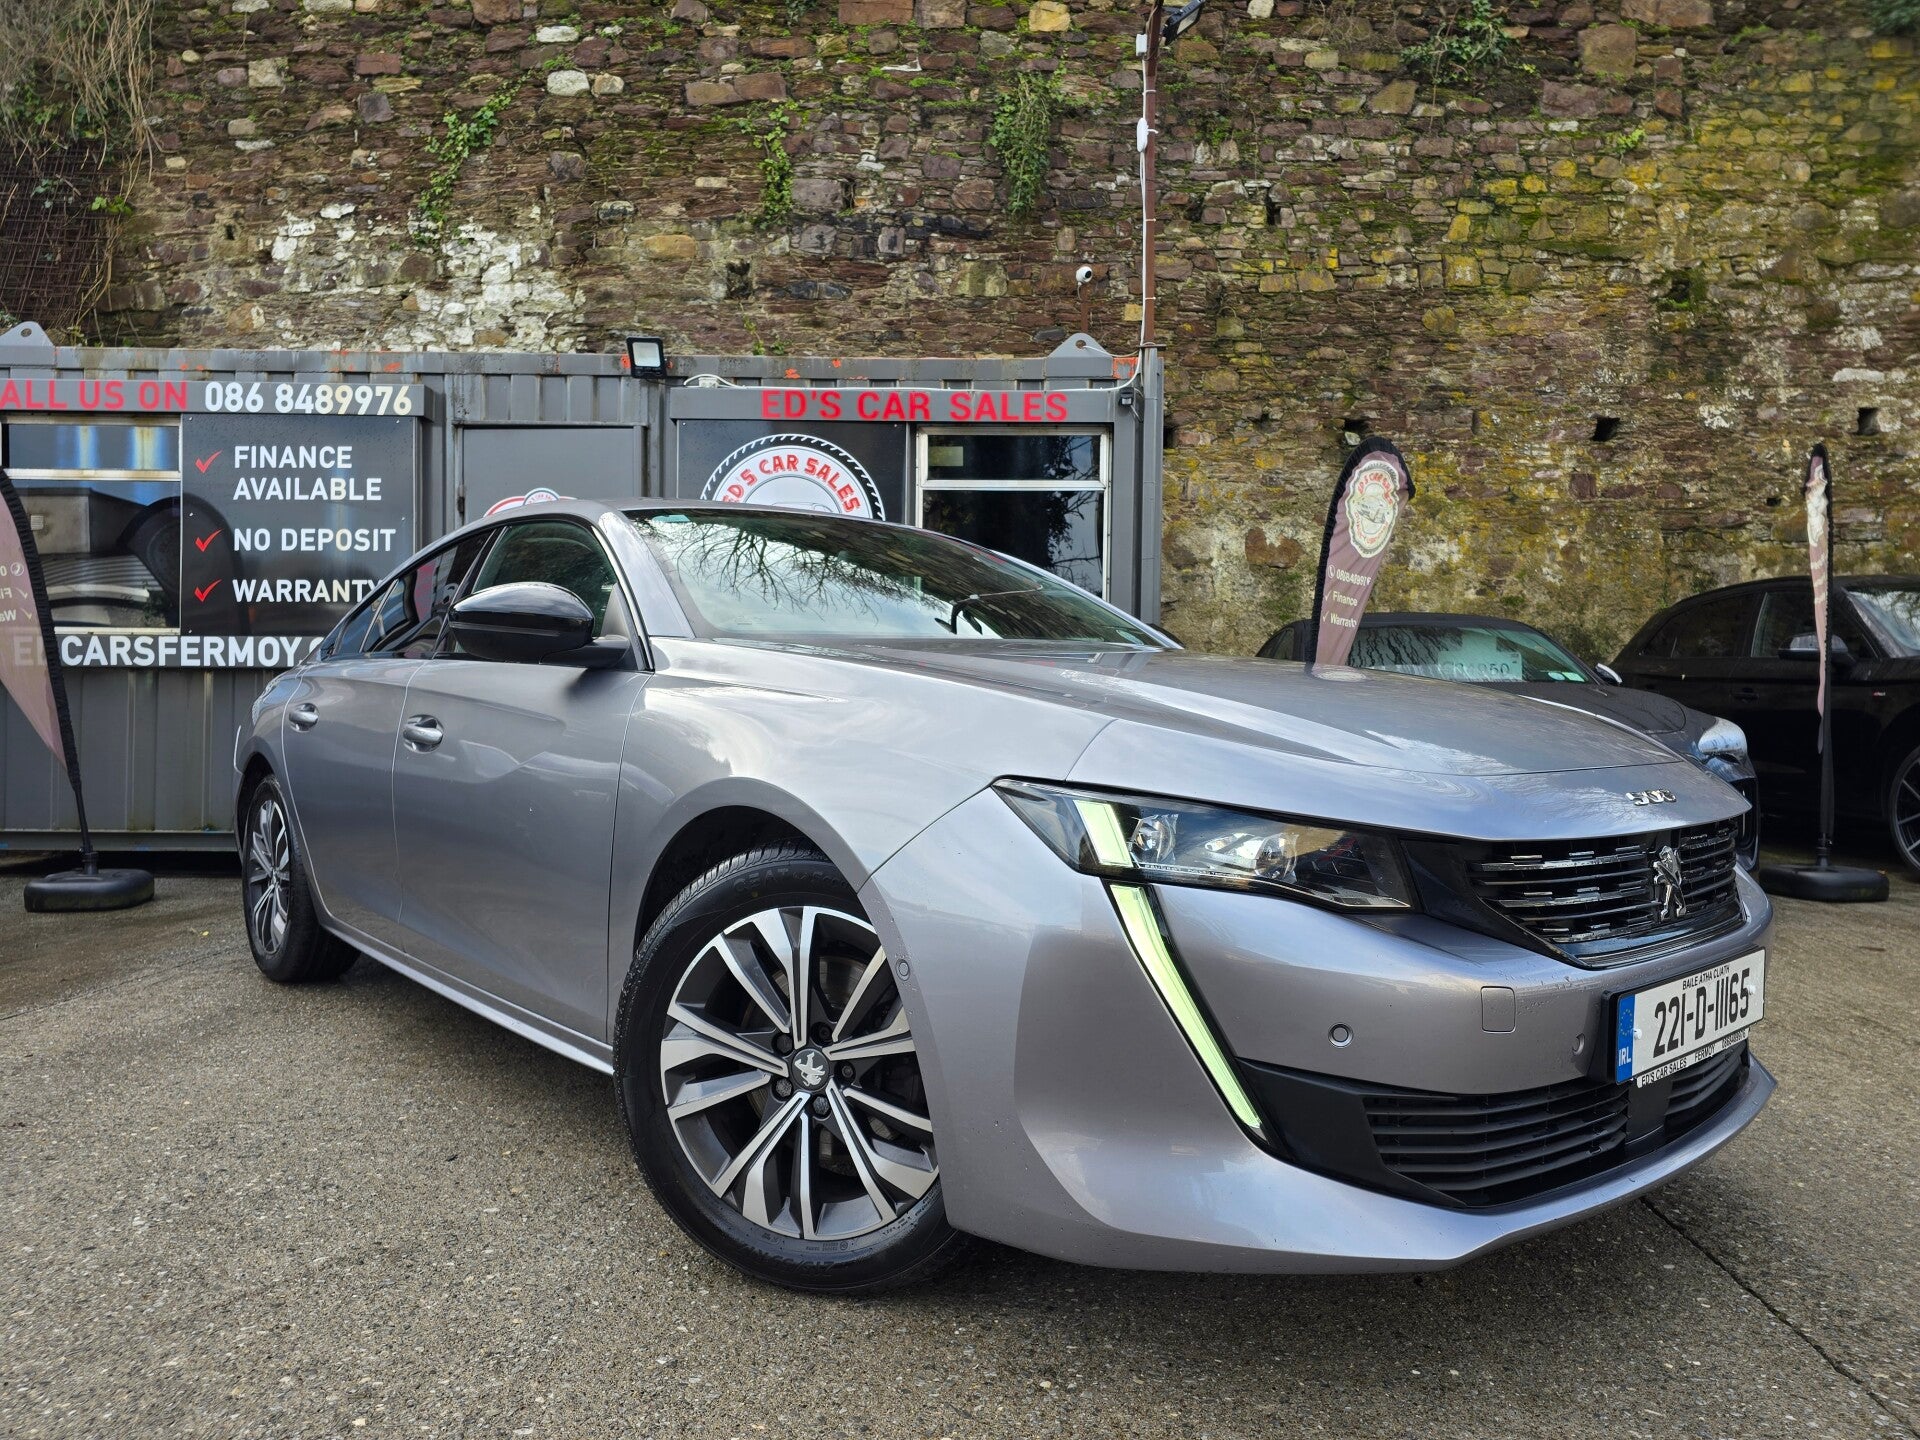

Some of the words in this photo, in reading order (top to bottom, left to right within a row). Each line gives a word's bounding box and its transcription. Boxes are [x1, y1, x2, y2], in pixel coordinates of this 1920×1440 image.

[79, 380, 125, 410] US
[139, 381, 187, 411] ON
[205, 382, 263, 412] 086
[275, 384, 412, 416] 8489976
[762, 390, 841, 420] ED'S
[858, 391, 930, 421] CAR
[950, 391, 1068, 422] SALES
[234, 445, 352, 469] FINANCE
[233, 477, 382, 501] AVAILABLE
[759, 455, 799, 475] CAR
[804, 457, 861, 513] SALES
[234, 528, 271, 552] NO
[281, 528, 397, 552] DEPOSIT
[1332, 590, 1358, 607] Finance
[1682, 976, 1699, 990] BAILE
[1653, 967, 1750, 1058] 221-D-11165
[1618, 1047, 1633, 1067] IRL
[1655, 1066, 1668, 1081] CAR
[1669, 1057, 1688, 1074] SALES
